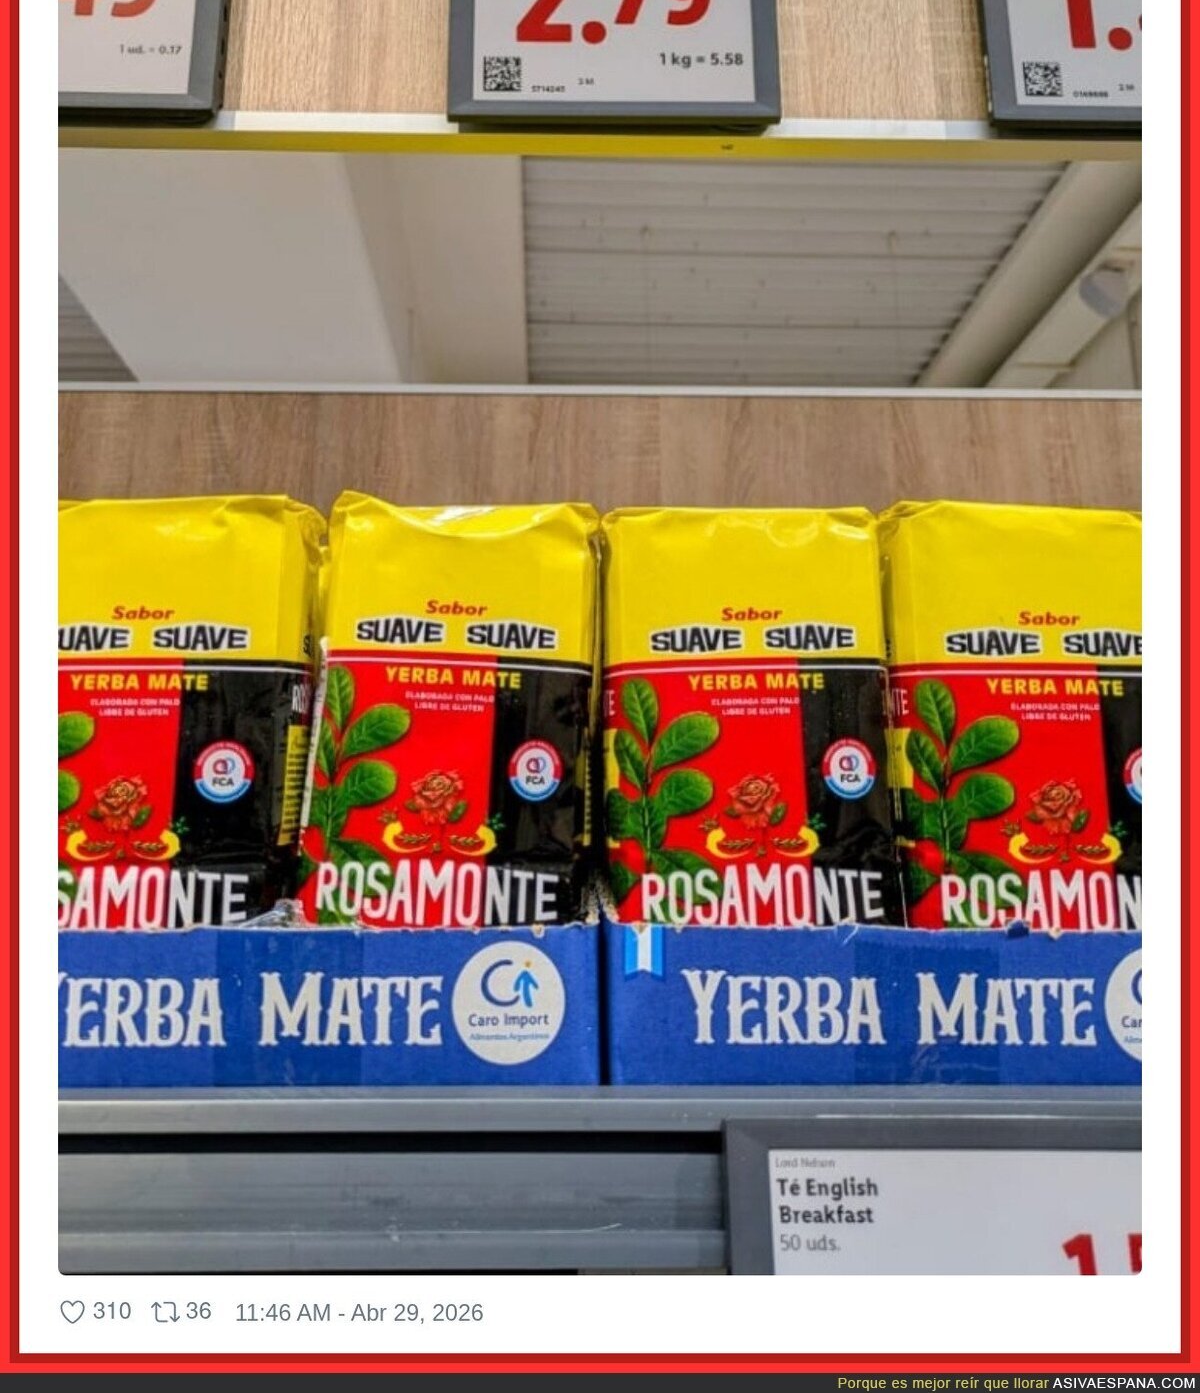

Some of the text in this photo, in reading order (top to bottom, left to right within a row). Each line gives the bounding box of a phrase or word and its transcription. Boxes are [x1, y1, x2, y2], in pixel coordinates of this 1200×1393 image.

[158, 45, 183, 56] 0.17
[659, 53, 666, 65] 1
[671, 52, 692, 68] kg
[711, 52, 744, 66] 5.58
[112, 606, 174, 620] Sabor
[426, 600, 488, 616] Sabor
[721, 607, 782, 622] Sabor
[1018, 611, 1080, 626] Sabor
[153, 625, 248, 650] SUAVE
[356, 618, 556, 649] SUAVE SUAVE
[651, 625, 854, 653] SUAVE SUAVE
[946, 630, 1041, 656] SUAVE
[71, 674, 208, 691] YERBA MATE
[386, 666, 522, 689] YERBA MATE
[688, 673, 825, 691] YERBA MATE
[987, 678, 1124, 696] YERBA MATE
[212, 777, 234, 786] FCA
[525, 775, 545, 785] FCA
[841, 773, 860, 783] FCA
[316, 859, 559, 926] ROSAMONTE
[641, 863, 885, 926] ROSAMONTE
[258, 972, 443, 1046] MATE
[680, 968, 1097, 1046] YERBA MATE
[468, 1013, 550, 1028] Caro Import
[776, 1176, 878, 1201] Té English
[780, 1204, 873, 1224] Breakfast
[780, 1234, 841, 1251] 50 uds.
